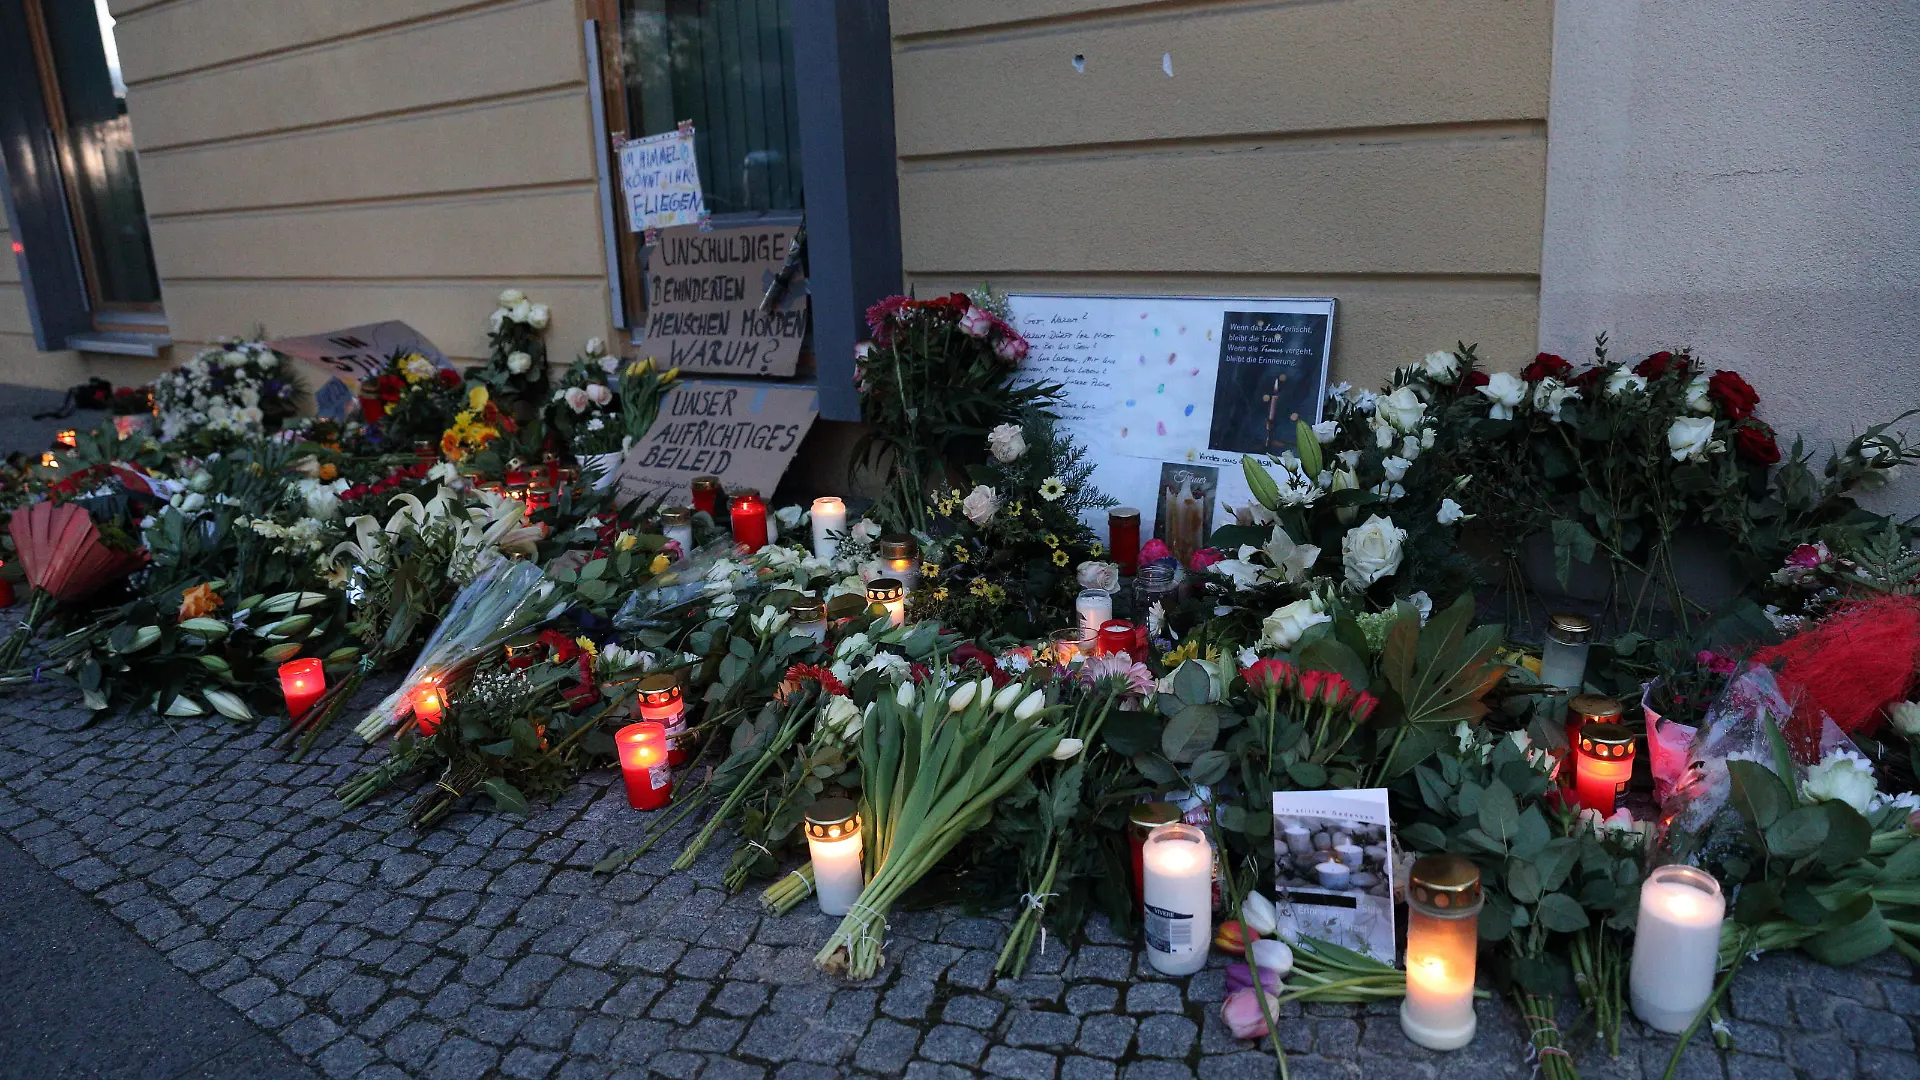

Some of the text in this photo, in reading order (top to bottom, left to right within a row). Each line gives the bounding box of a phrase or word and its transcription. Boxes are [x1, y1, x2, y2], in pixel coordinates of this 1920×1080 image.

[640, 145, 681, 168] HIMMEL
[633, 190, 704, 216] FLIEGEN
[661, 233, 785, 266] UNSCHULDIGE
[652, 275, 746, 306] BEHINDERTEN
[648, 309, 807, 339] MENSCHEN MORDEN
[1229, 323, 1249, 332] Wenn
[1250, 324, 1263, 332] das
[1228, 333, 1248, 342] bleibt
[1227, 344, 1247, 352] Wenn
[1247, 345, 1259, 353] die
[1225, 355, 1245, 363] bleibt
[671, 388, 738, 417] UNSER
[651, 419, 800, 452] AUFRICHTIGES
[638, 444, 732, 475] BEILEID
[1222, 457, 1238, 465] aus
[1173, 469, 1208, 485] Trauer
[1331, 810, 1376, 820] Gedenken
[1153, 907, 1175, 918] VIVERE
